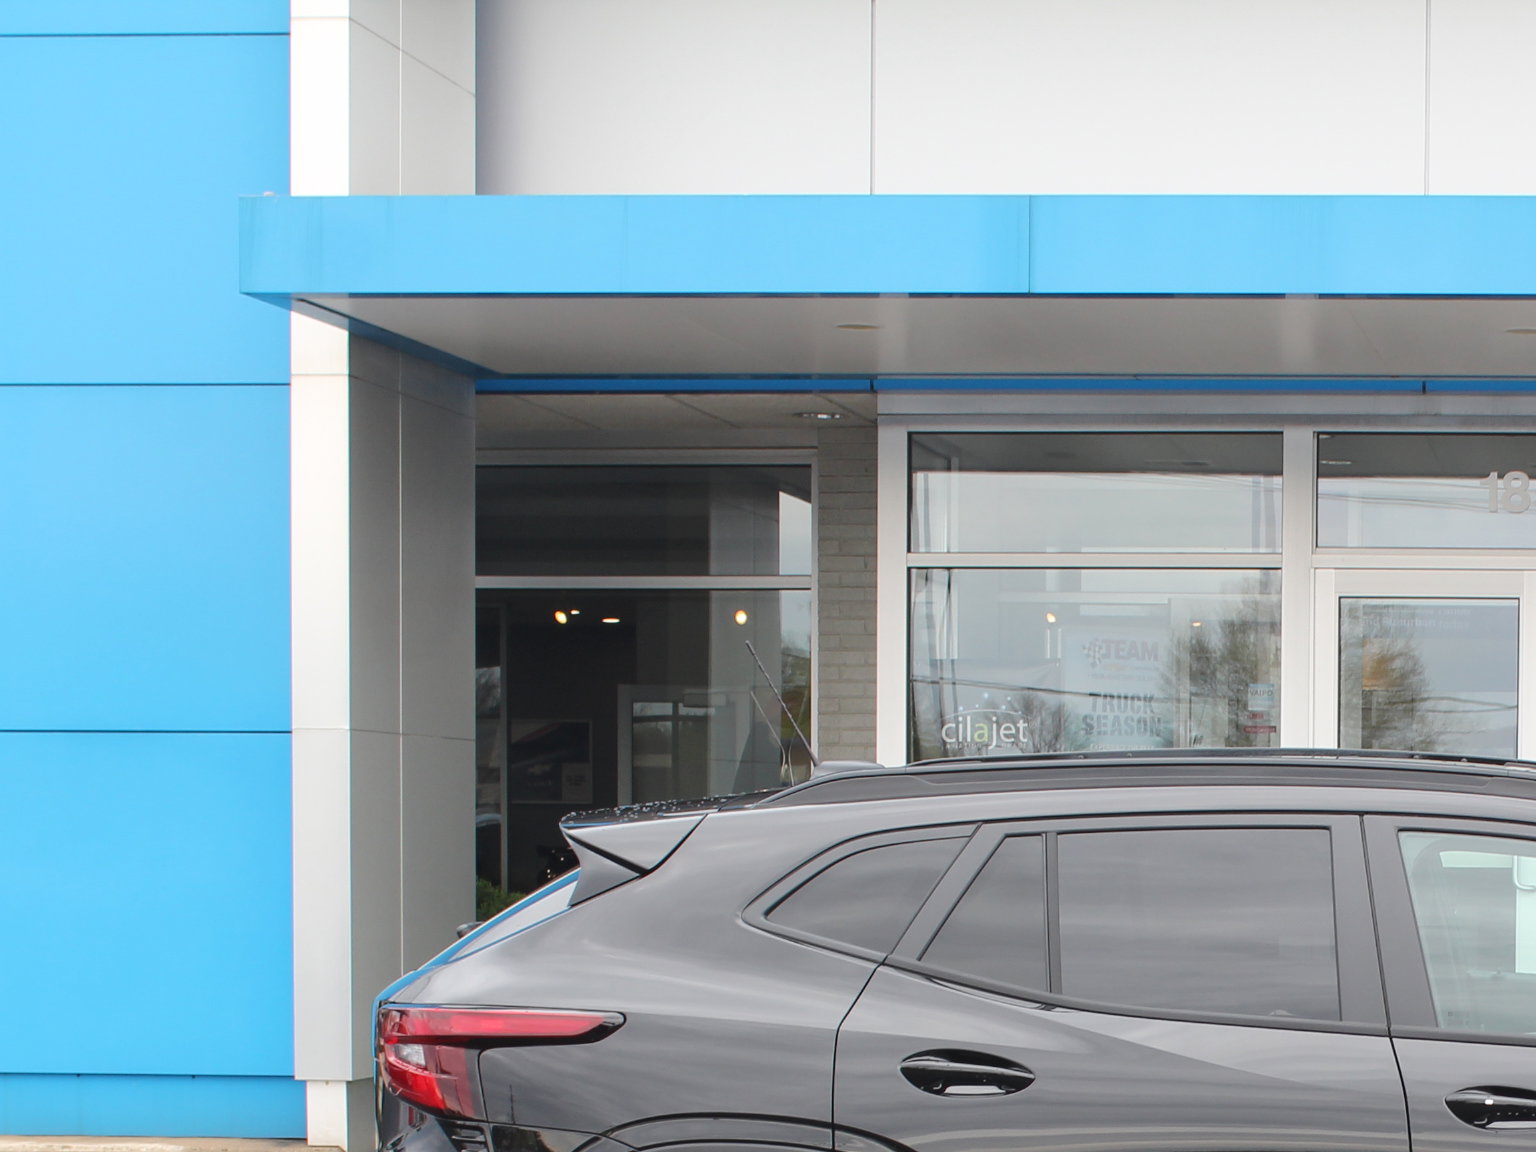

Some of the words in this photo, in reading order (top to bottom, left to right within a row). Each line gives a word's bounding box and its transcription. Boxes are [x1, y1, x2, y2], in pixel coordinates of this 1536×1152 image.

[1101, 639, 1159, 662] TEAM
[1089, 691, 1155, 714] TRUCK
[941, 715, 1028, 750] cilajet
[1081, 713, 1161, 737] SEASON
